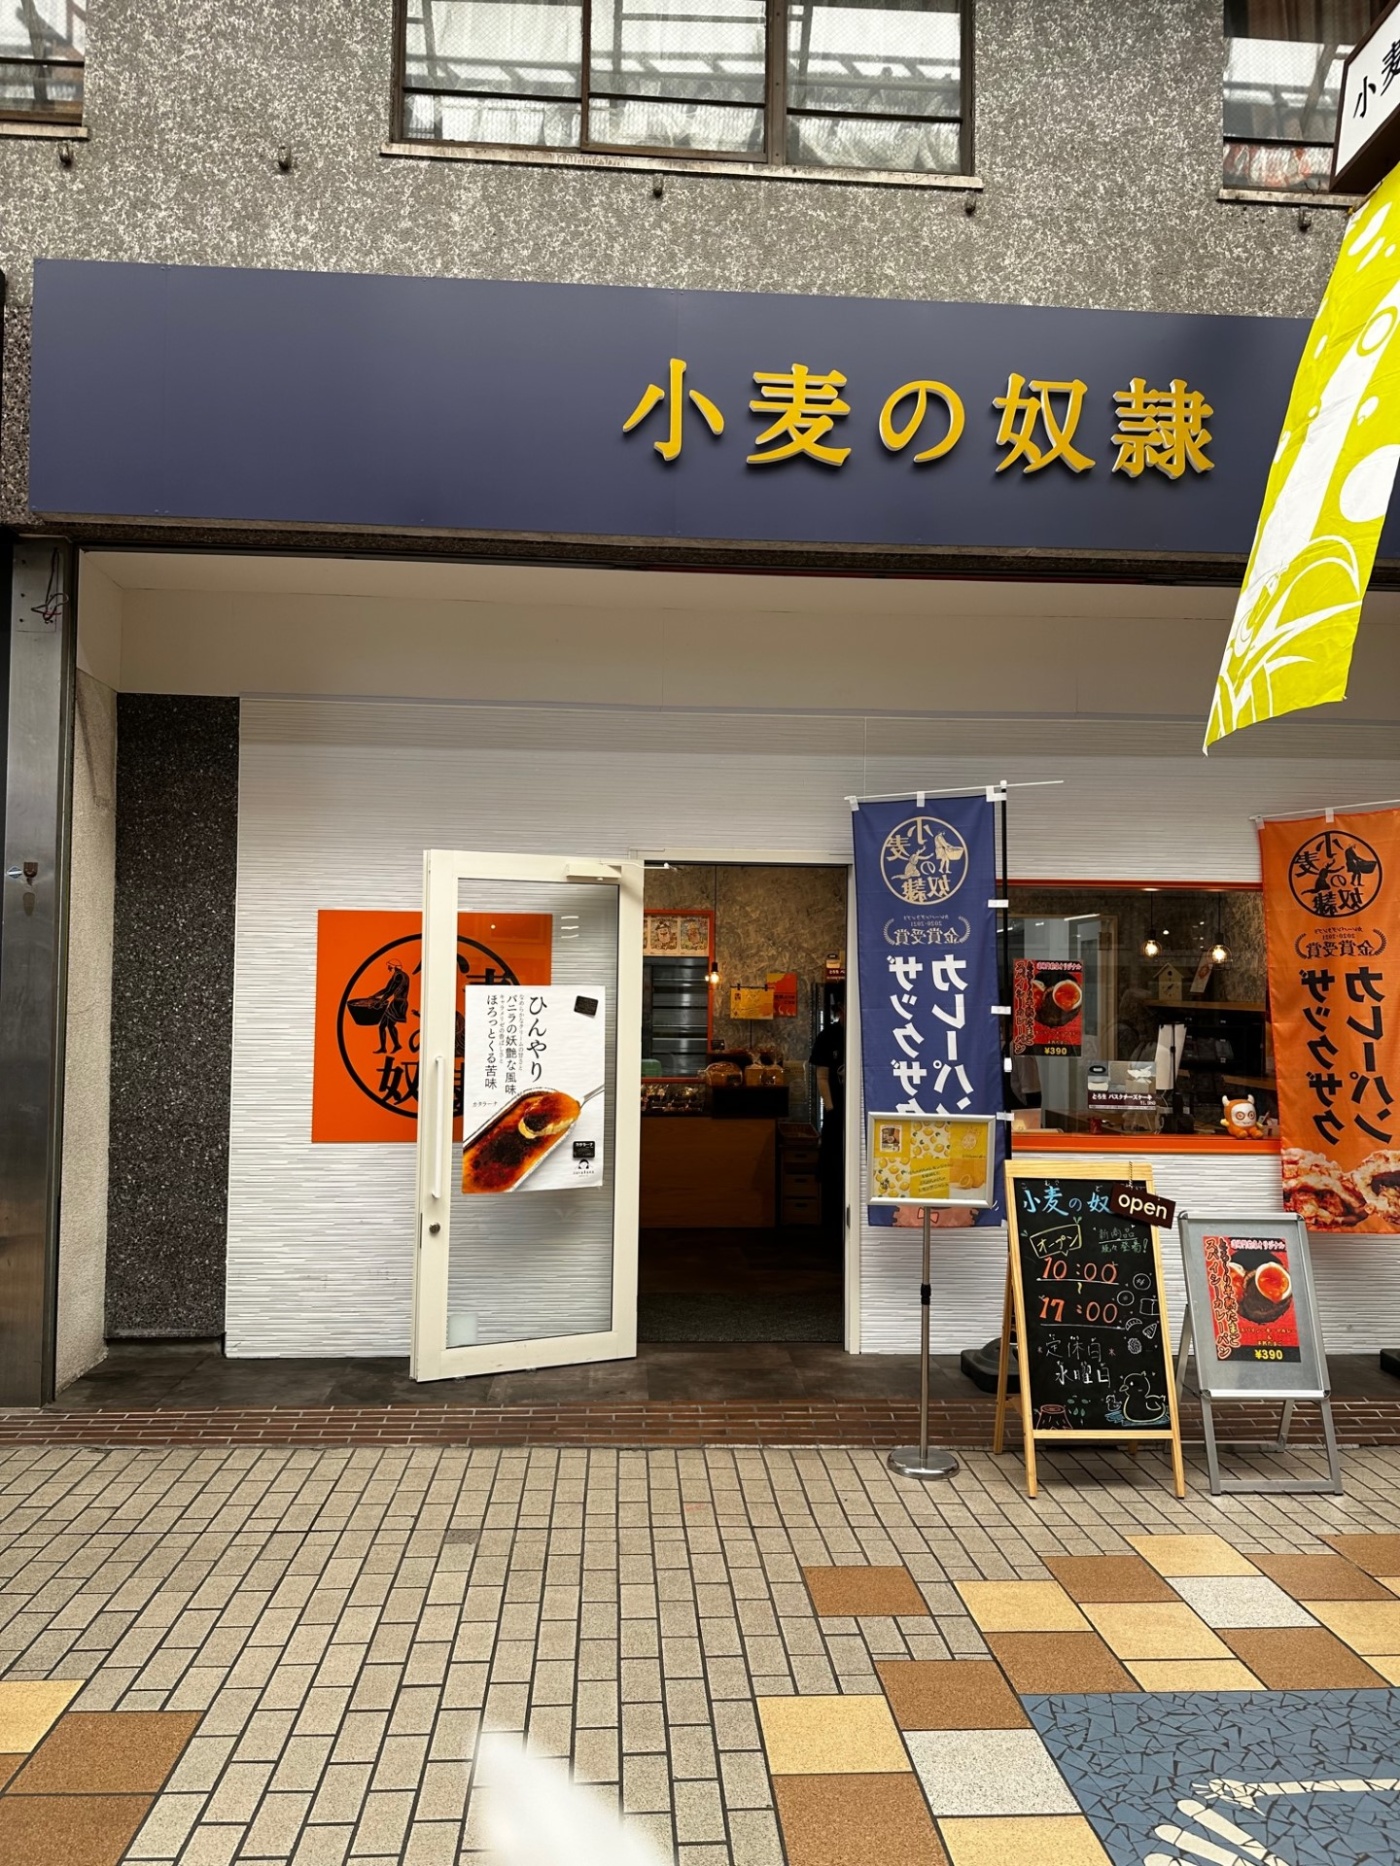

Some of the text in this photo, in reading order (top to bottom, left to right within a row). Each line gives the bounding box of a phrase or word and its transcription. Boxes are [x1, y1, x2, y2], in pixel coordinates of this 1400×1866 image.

[622, 357, 1215, 479] 小麦の奴隷
[484, 994, 498, 1090] ほろっとくる苦味
[526, 996, 548, 1083] ひんやり
[1044, 1047, 1067, 1055] ¥390
[1118, 1194, 1167, 1220] open
[1037, 1234, 1079, 1253] オープン
[1042, 1257, 1118, 1284] 10:00
[1039, 1296, 1118, 1323] 17:00
[1254, 1349, 1283, 1360] ¥390
[1055, 1364, 1111, 1388] 水曜日
